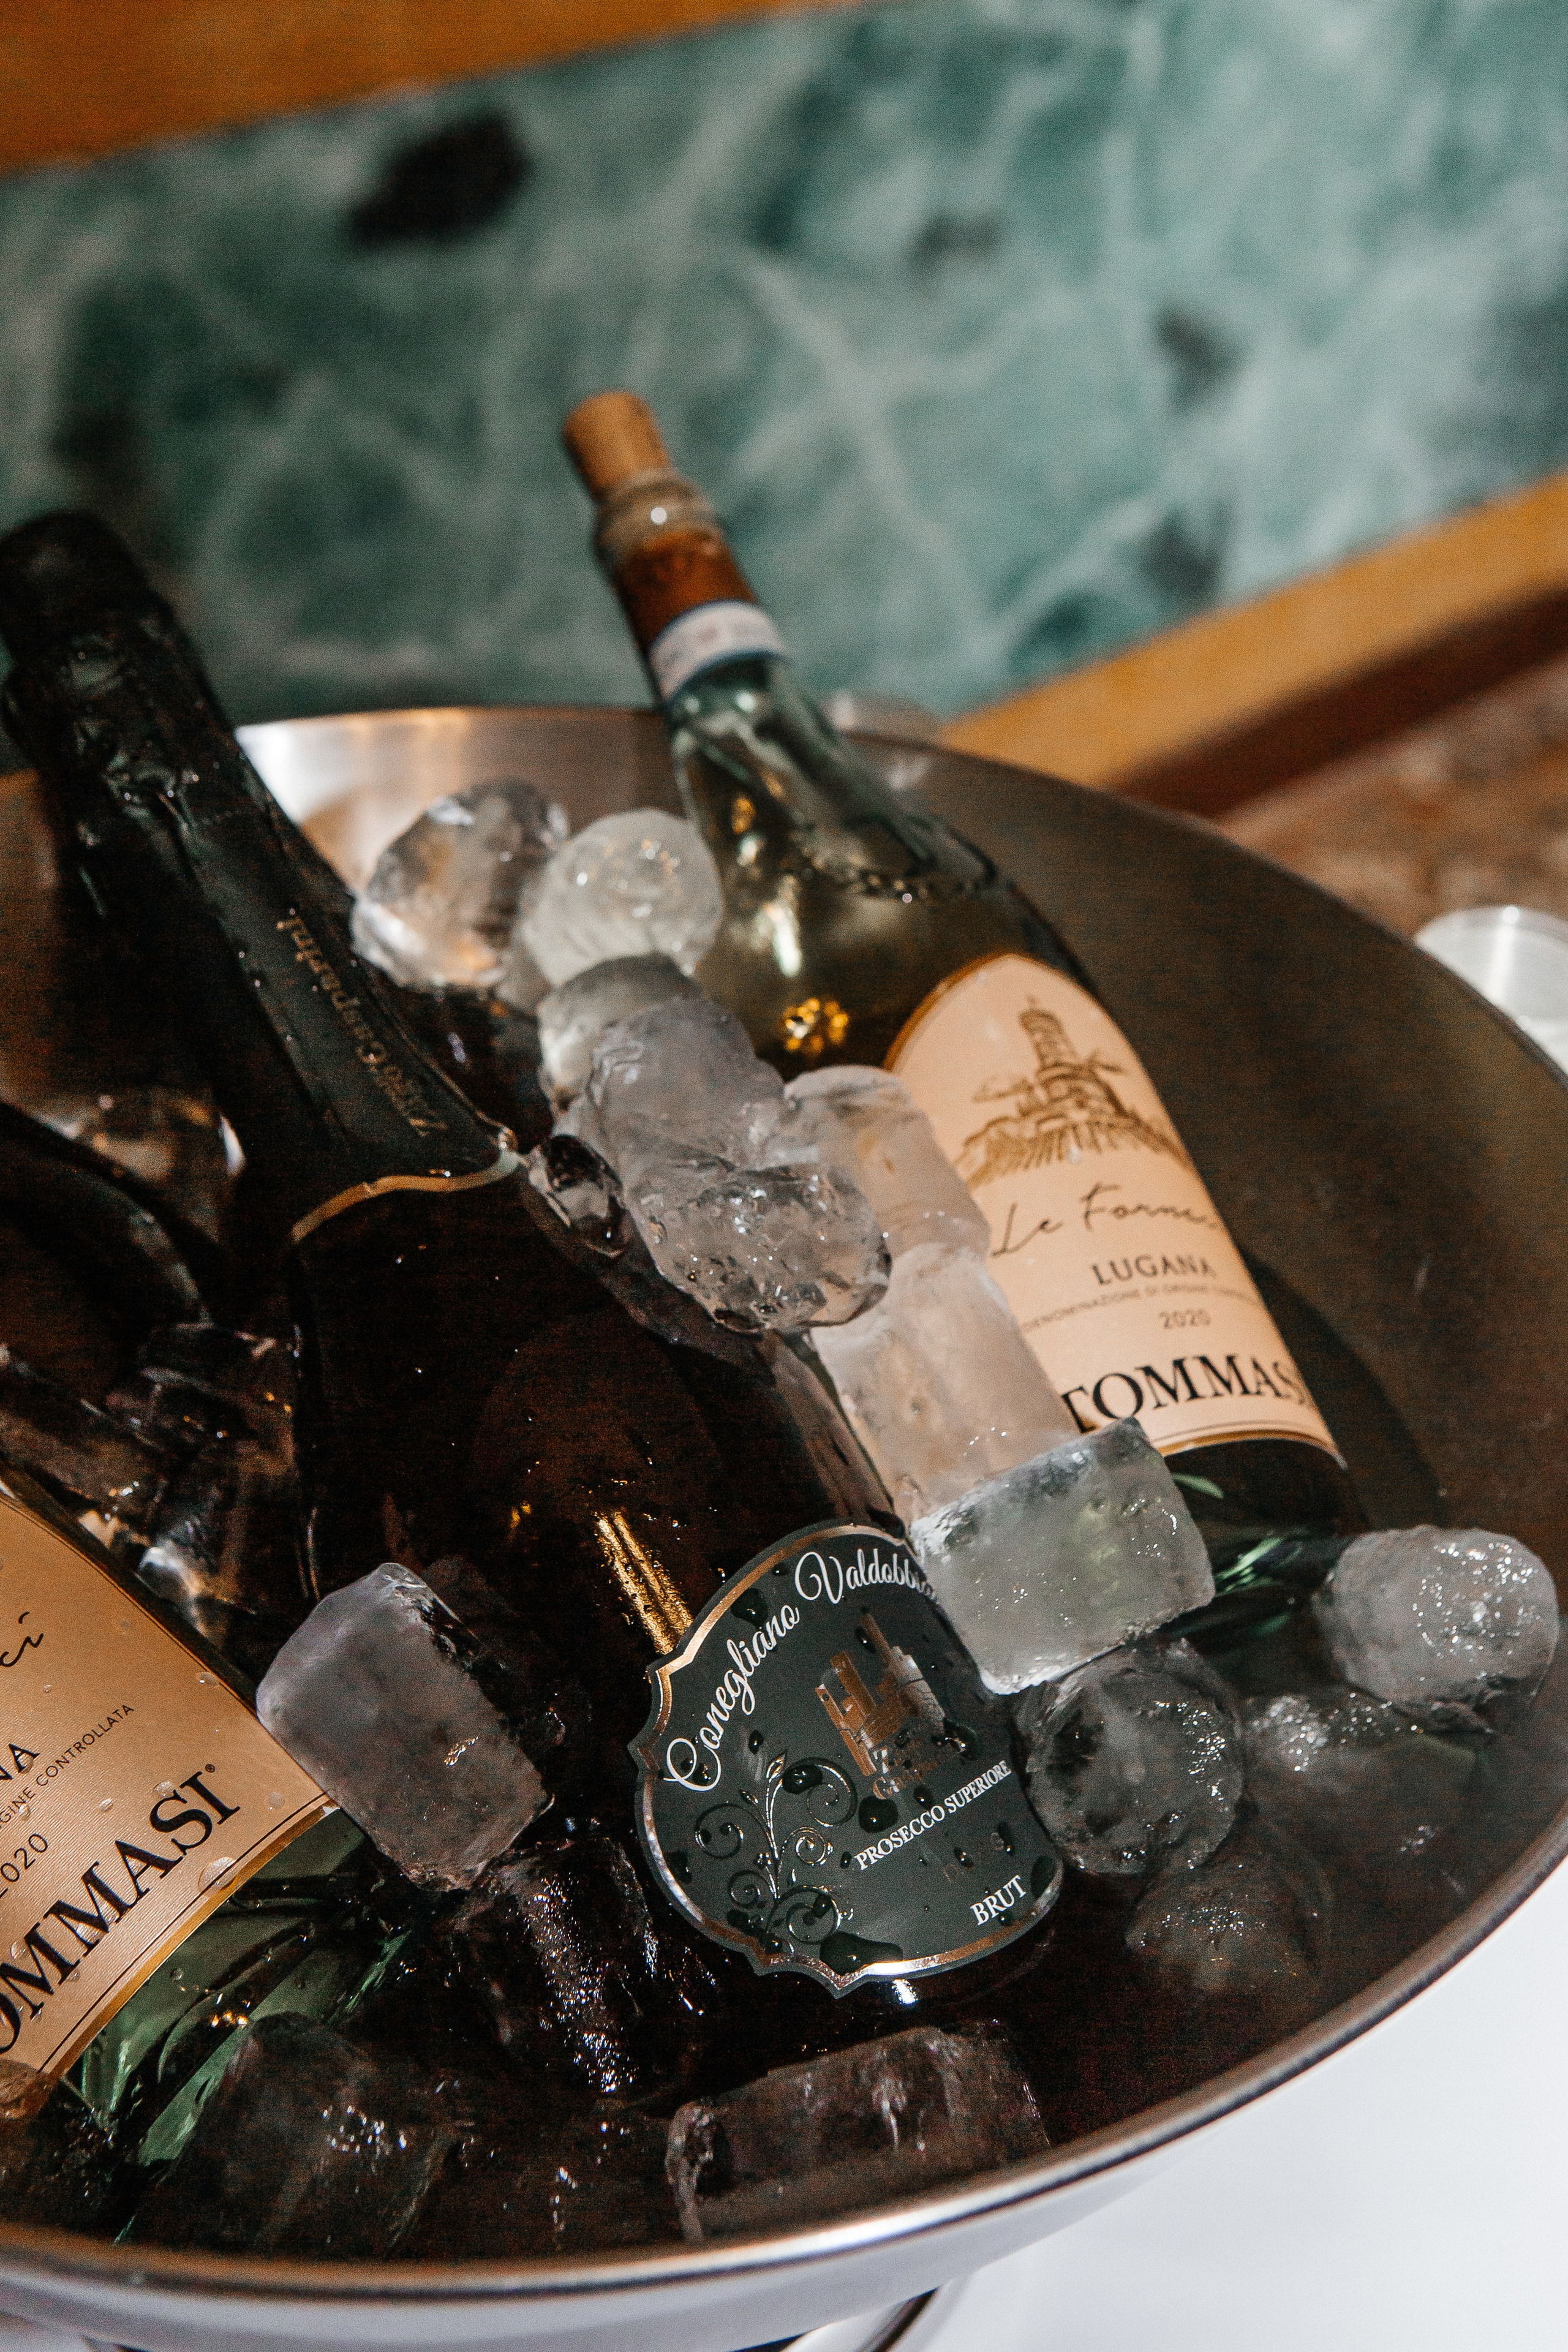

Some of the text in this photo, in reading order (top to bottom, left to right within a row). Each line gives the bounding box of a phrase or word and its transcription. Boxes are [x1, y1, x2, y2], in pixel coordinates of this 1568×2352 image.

[1090, 1254, 1217, 1285] LUGANA
[1159, 1308, 1211, 1329] 2020
[663, 1605, 800, 1792] Conegliano
[36, 1705, 134, 1786] CONTROLLATA
[854, 1805, 945, 1870] PROSECCO
[944, 1760, 1011, 1814] SUPERIORE
[970, 1874, 1027, 1926] BRUT
